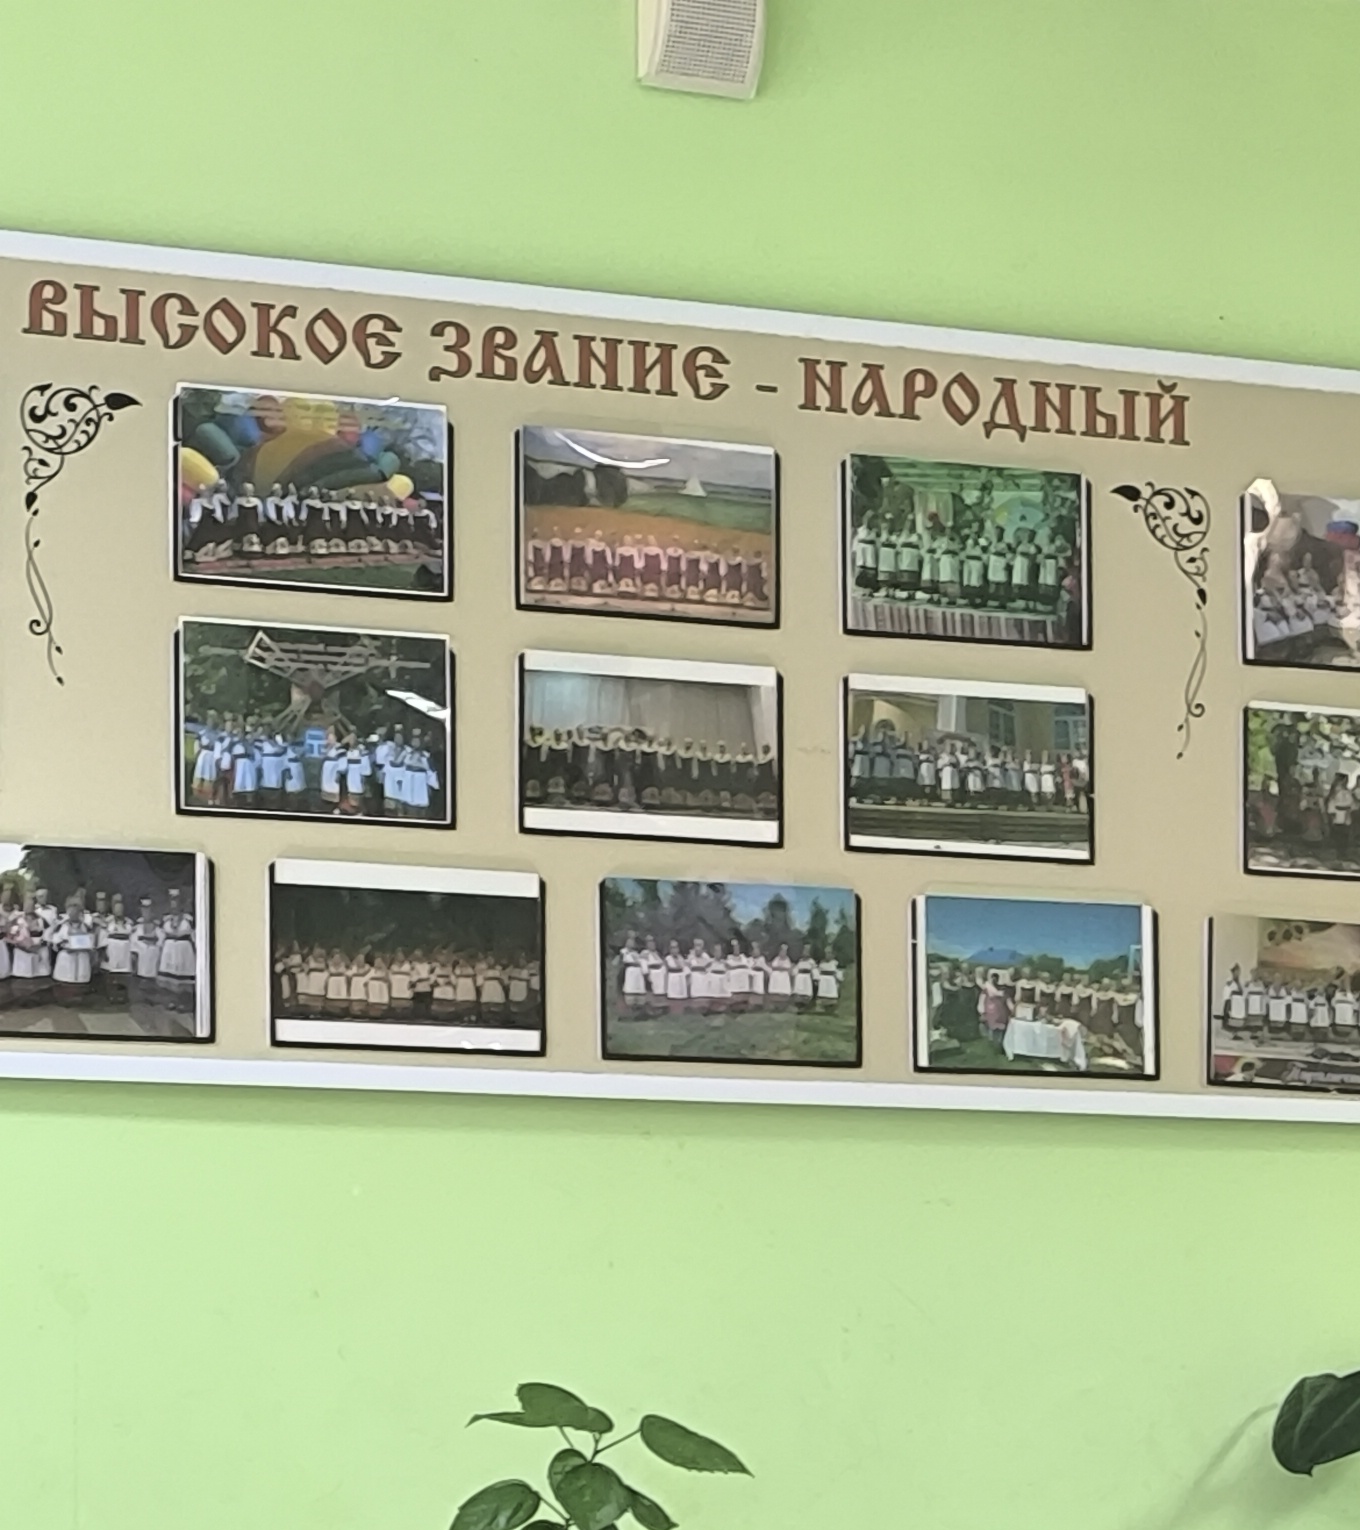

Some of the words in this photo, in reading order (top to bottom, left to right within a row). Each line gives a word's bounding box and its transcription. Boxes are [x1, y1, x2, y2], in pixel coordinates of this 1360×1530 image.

[22, 279, 402, 369] ВЫСОКОЕ
[428, 320, 730, 400] ЗВАНИЕ
[798, 357, 1190, 445] НАРОДНЫЙ
